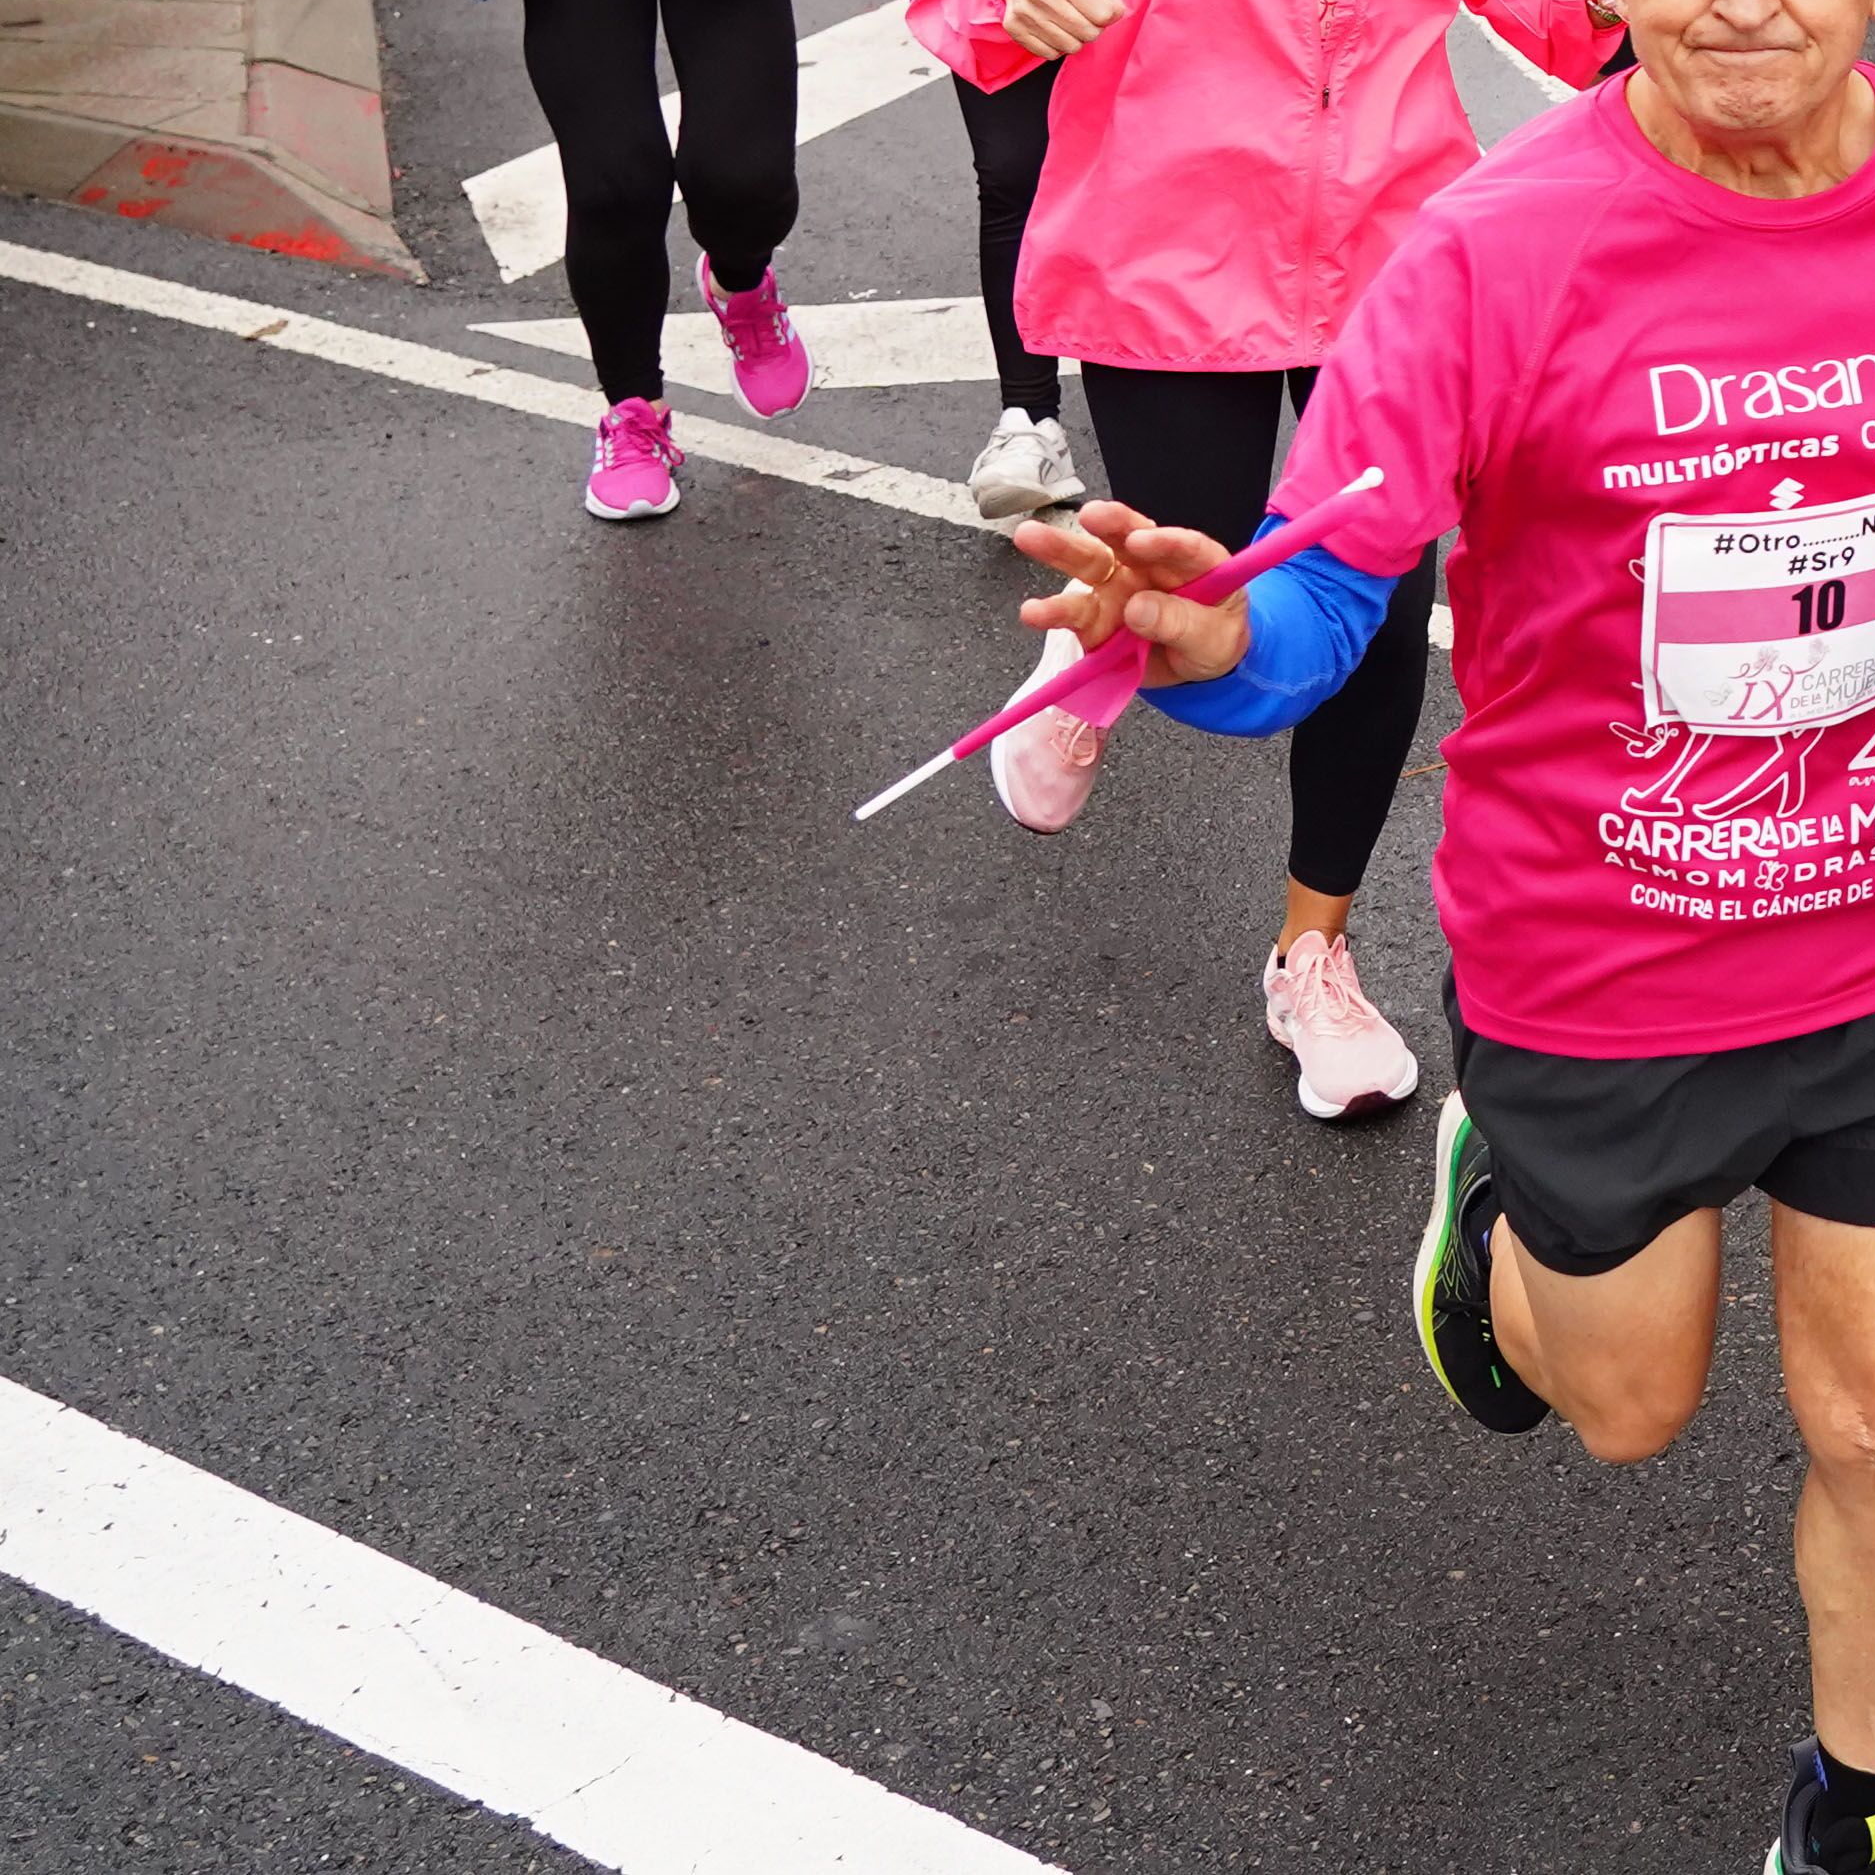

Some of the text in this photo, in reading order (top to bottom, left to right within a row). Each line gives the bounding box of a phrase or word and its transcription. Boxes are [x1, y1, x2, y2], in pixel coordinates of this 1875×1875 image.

[1788, 546, 1856, 575] #Sr9
[1791, 579, 1846, 634] 10
[1790, 696, 1809, 709] DE
[1599, 812, 1779, 862] CARRERA
[1781, 821, 1816, 851] DE
[1822, 818, 1845, 847] LA
[1604, 852, 1745, 889] ALMOM
[1631, 883, 1714, 920] CONTRA
[1719, 899, 1747, 921] EL
[1752, 889, 1842, 918] CÁNCER
[1847, 877, 1875, 902] DE
